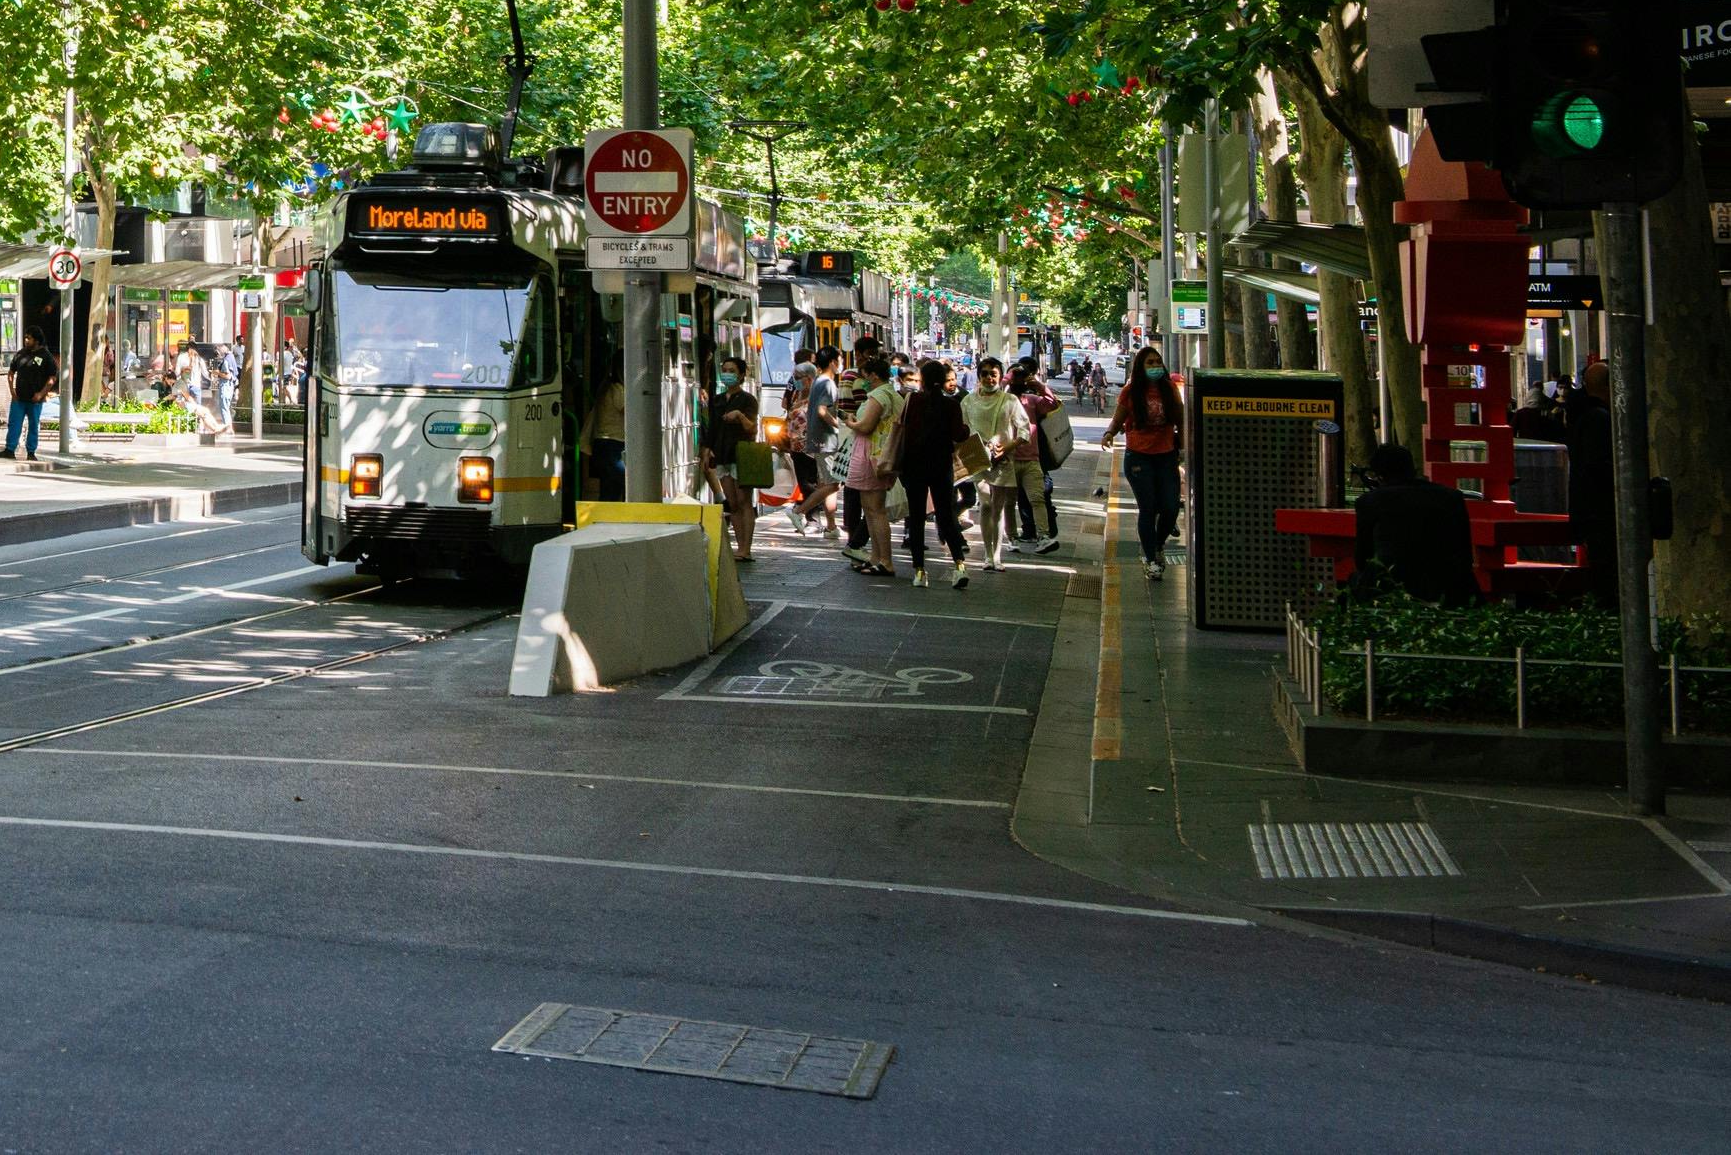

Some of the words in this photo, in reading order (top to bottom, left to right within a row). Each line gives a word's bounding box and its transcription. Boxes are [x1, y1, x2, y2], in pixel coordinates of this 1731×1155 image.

[621, 148, 653, 169] NO
[603, 196, 672, 215] ENTRY
[370, 206, 456, 229] Moreland
[459, 208, 487, 229] via
[602, 242, 639, 251] BICYCLES
[640, 243, 647, 251] &
[647, 242, 674, 251] TRAMS
[56, 260, 75, 275] 30
[619, 256, 657, 265] EXCEPTED
[822, 255, 833, 269] 16
[1527, 282, 1551, 293] ATM
[524, 403, 543, 421] 200
[1207, 400, 1232, 411] KEEP
[1235, 402, 1296, 413] MELBOURNE
[1298, 403, 1331, 414] CLEAN
